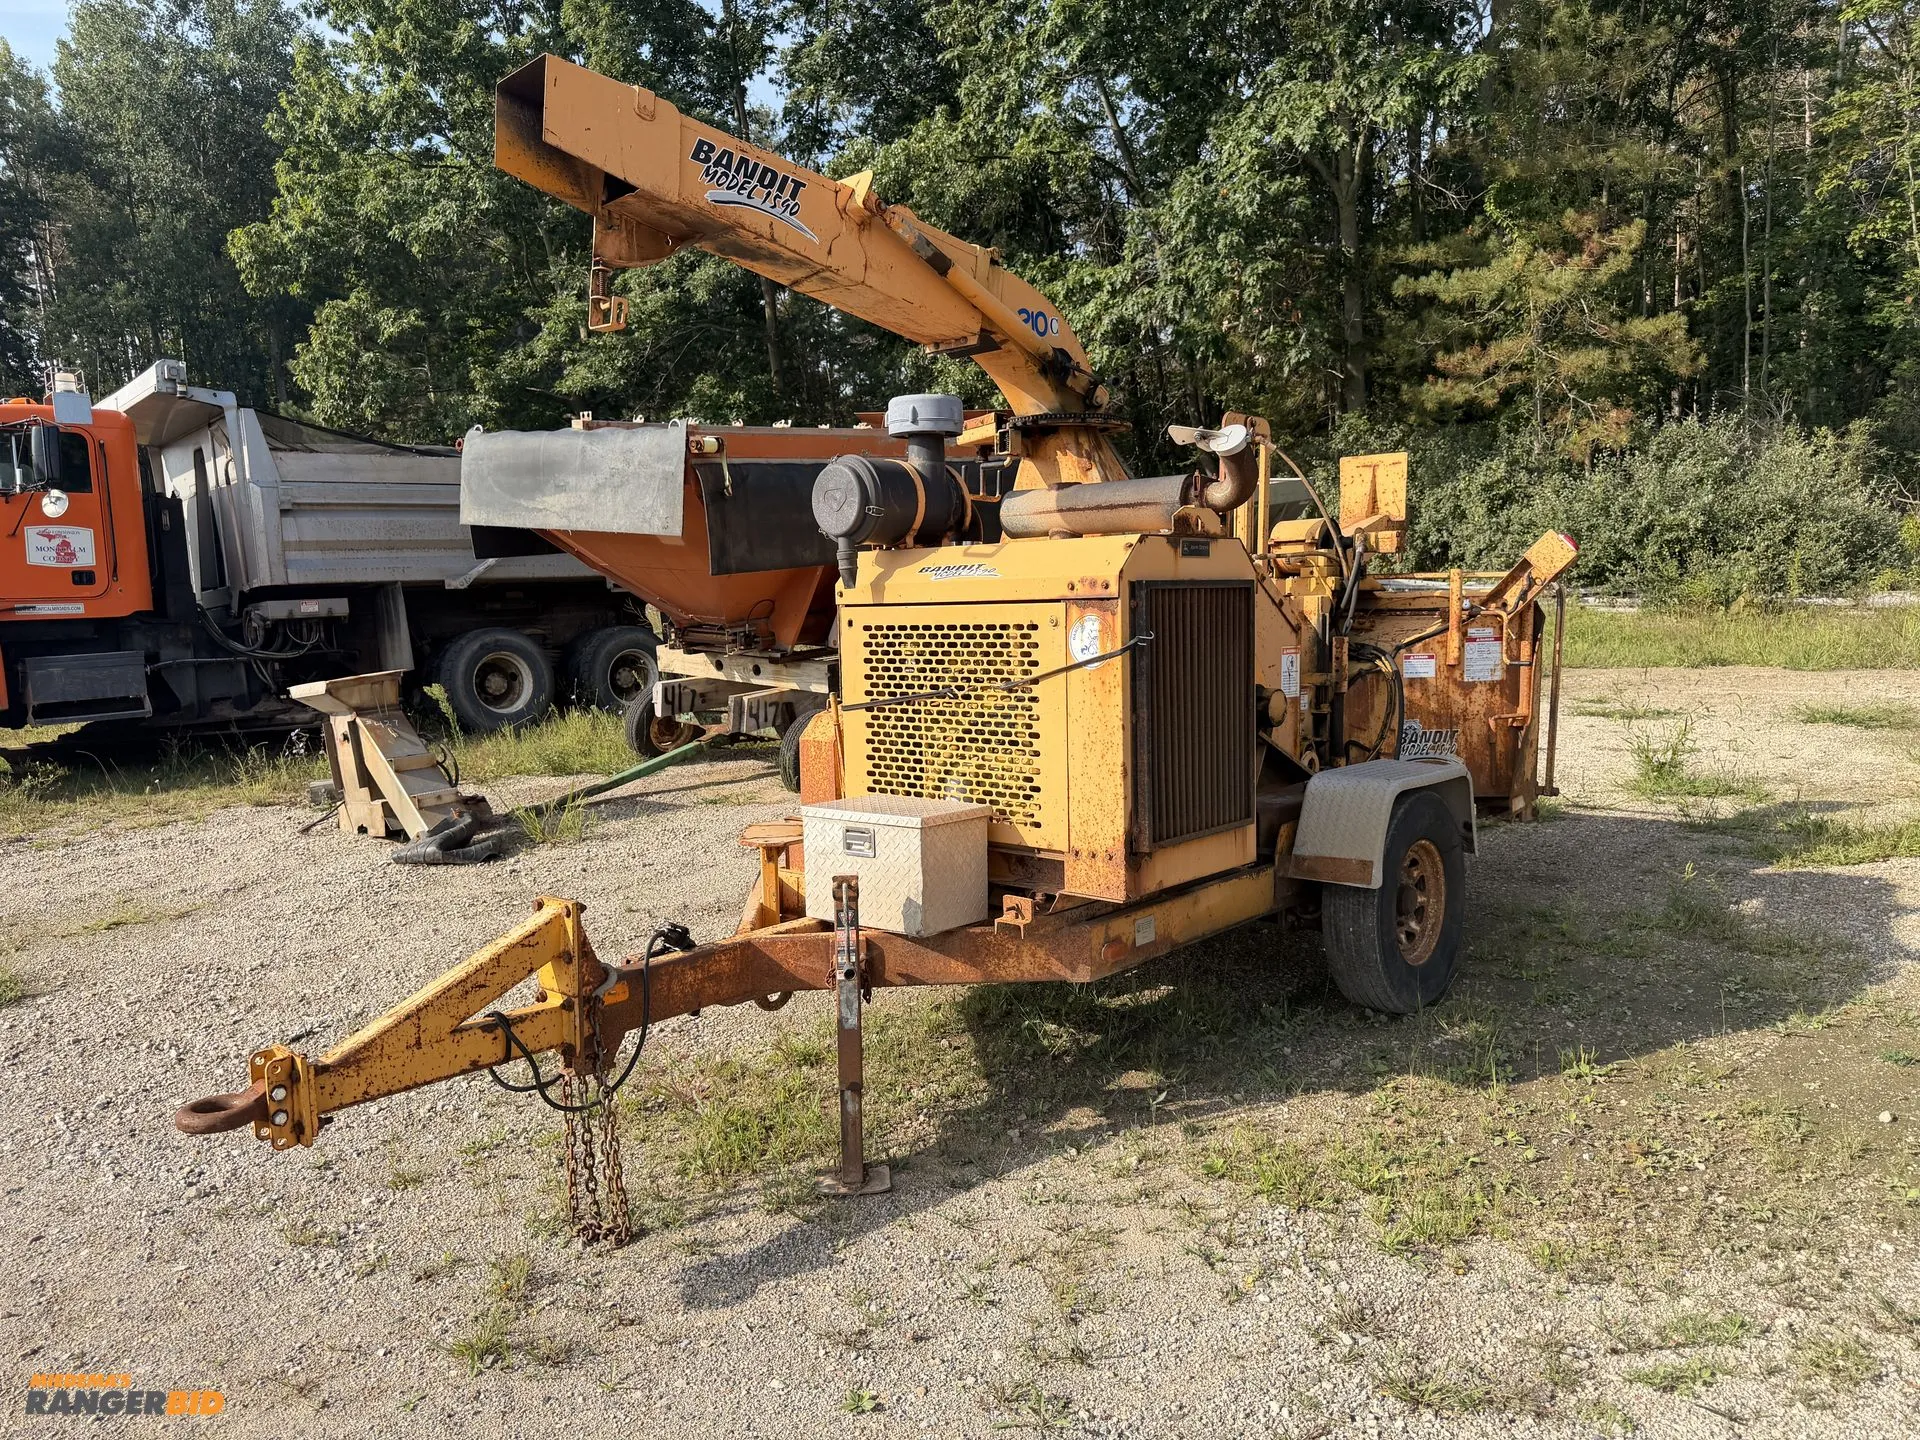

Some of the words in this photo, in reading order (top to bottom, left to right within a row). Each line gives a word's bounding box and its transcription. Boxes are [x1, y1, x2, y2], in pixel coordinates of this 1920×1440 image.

[689, 137, 808, 202] BANDIT
[698, 164, 760, 201] MODEL
[760, 189, 802, 217] 1590
[918, 563, 986, 574] BANDIT
[664, 683, 697, 720] 417
[1401, 729, 1460, 744] BANDIT
